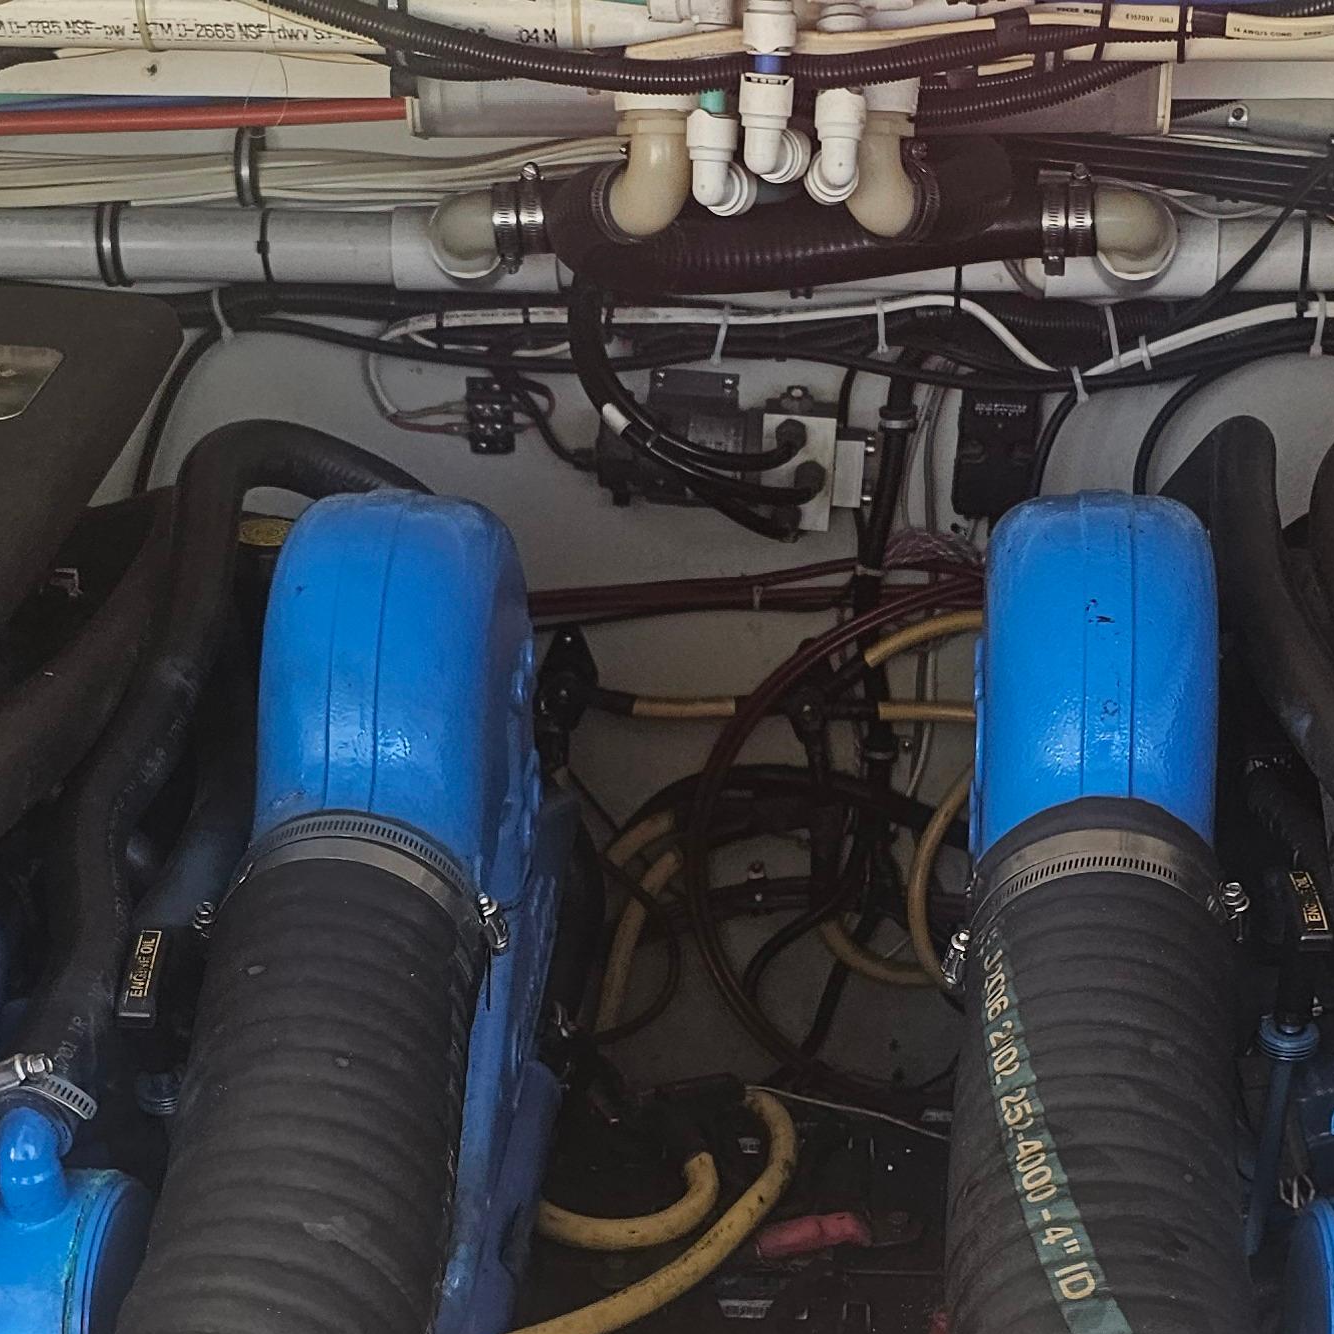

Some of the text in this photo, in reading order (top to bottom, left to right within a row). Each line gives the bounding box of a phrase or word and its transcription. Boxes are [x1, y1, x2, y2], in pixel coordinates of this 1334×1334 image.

[132, 22, 173, 37] ATM
[140, 938, 156, 954] OIL
[1054, 1261, 1097, 1300] ID
